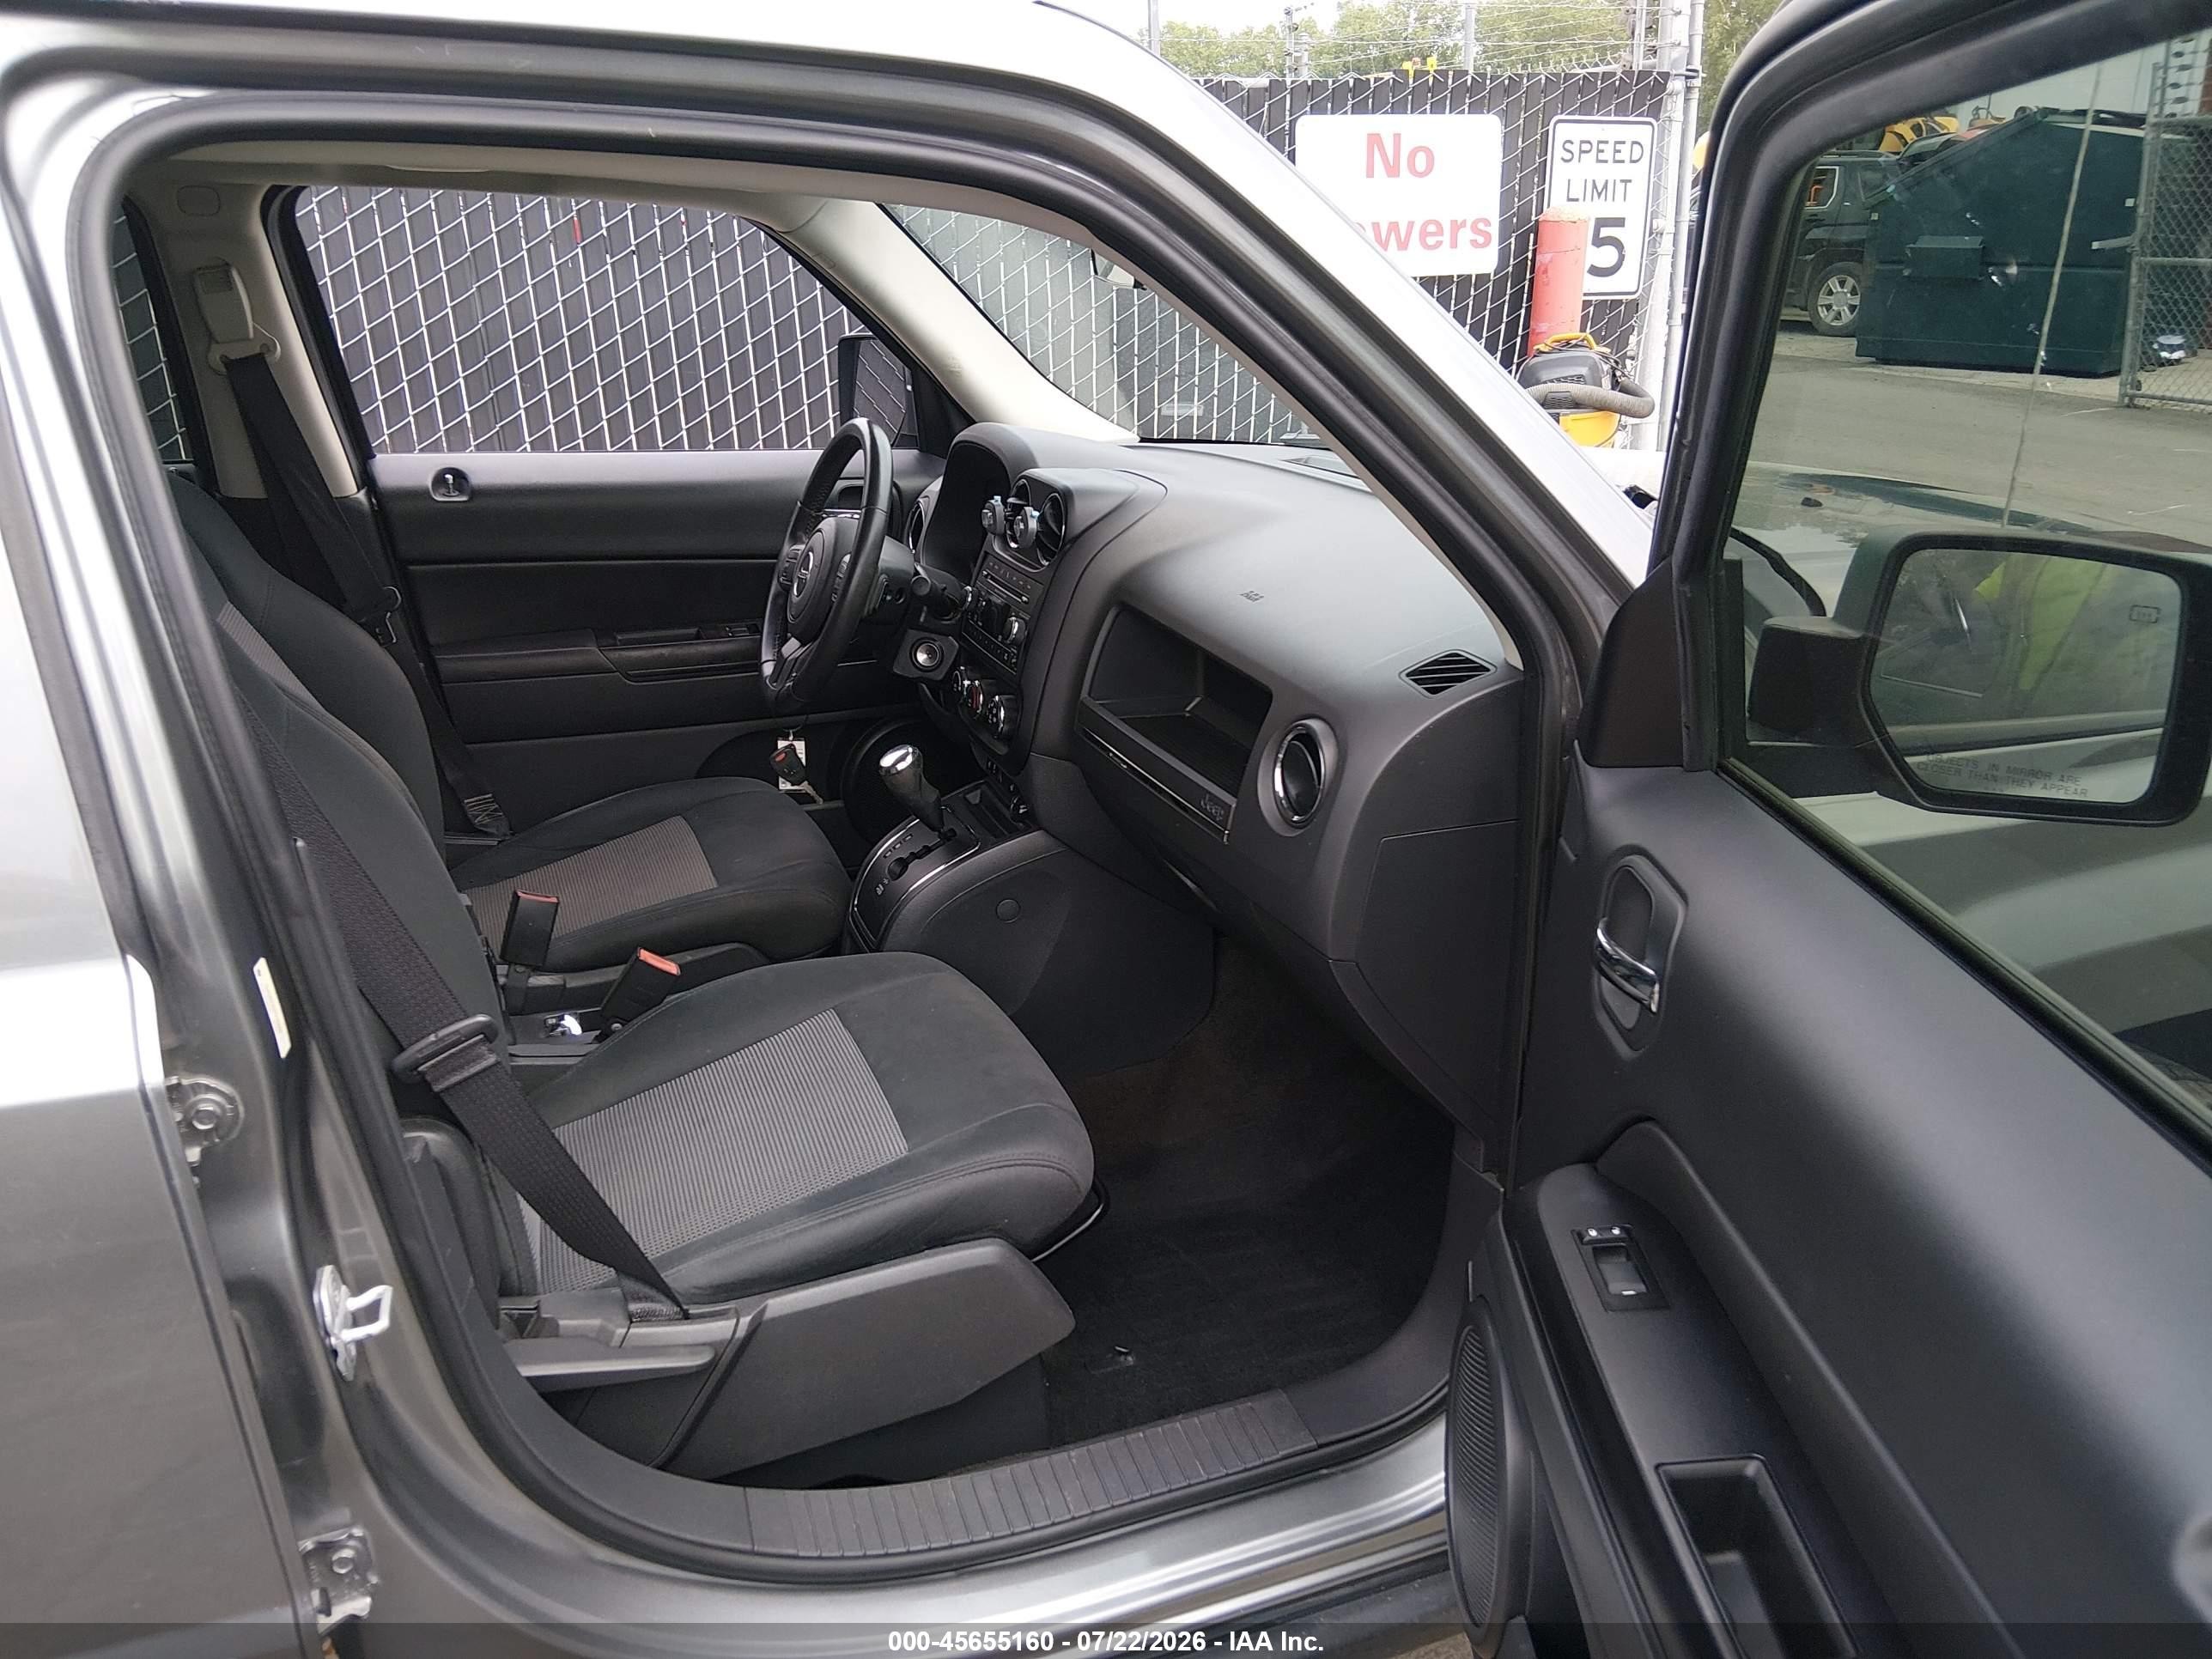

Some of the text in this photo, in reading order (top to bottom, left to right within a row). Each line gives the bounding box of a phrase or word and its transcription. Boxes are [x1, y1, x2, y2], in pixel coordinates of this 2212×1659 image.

[1365, 132, 1435, 179] No
[1560, 139, 1644, 164] SPEED
[1566, 178, 1632, 203] LIMIT
[1354, 217, 1492, 252] wers
[1917, 762, 1963, 777] CLOSER
[1968, 771, 1998, 785] THAN
[2006, 775, 2035, 789] THEY
[2040, 781, 2088, 798] APPEAR
[1987, 763, 2000, 772] IN
[2006, 765, 2053, 781] MIRROR
[2058, 774, 2082, 786] ARE
